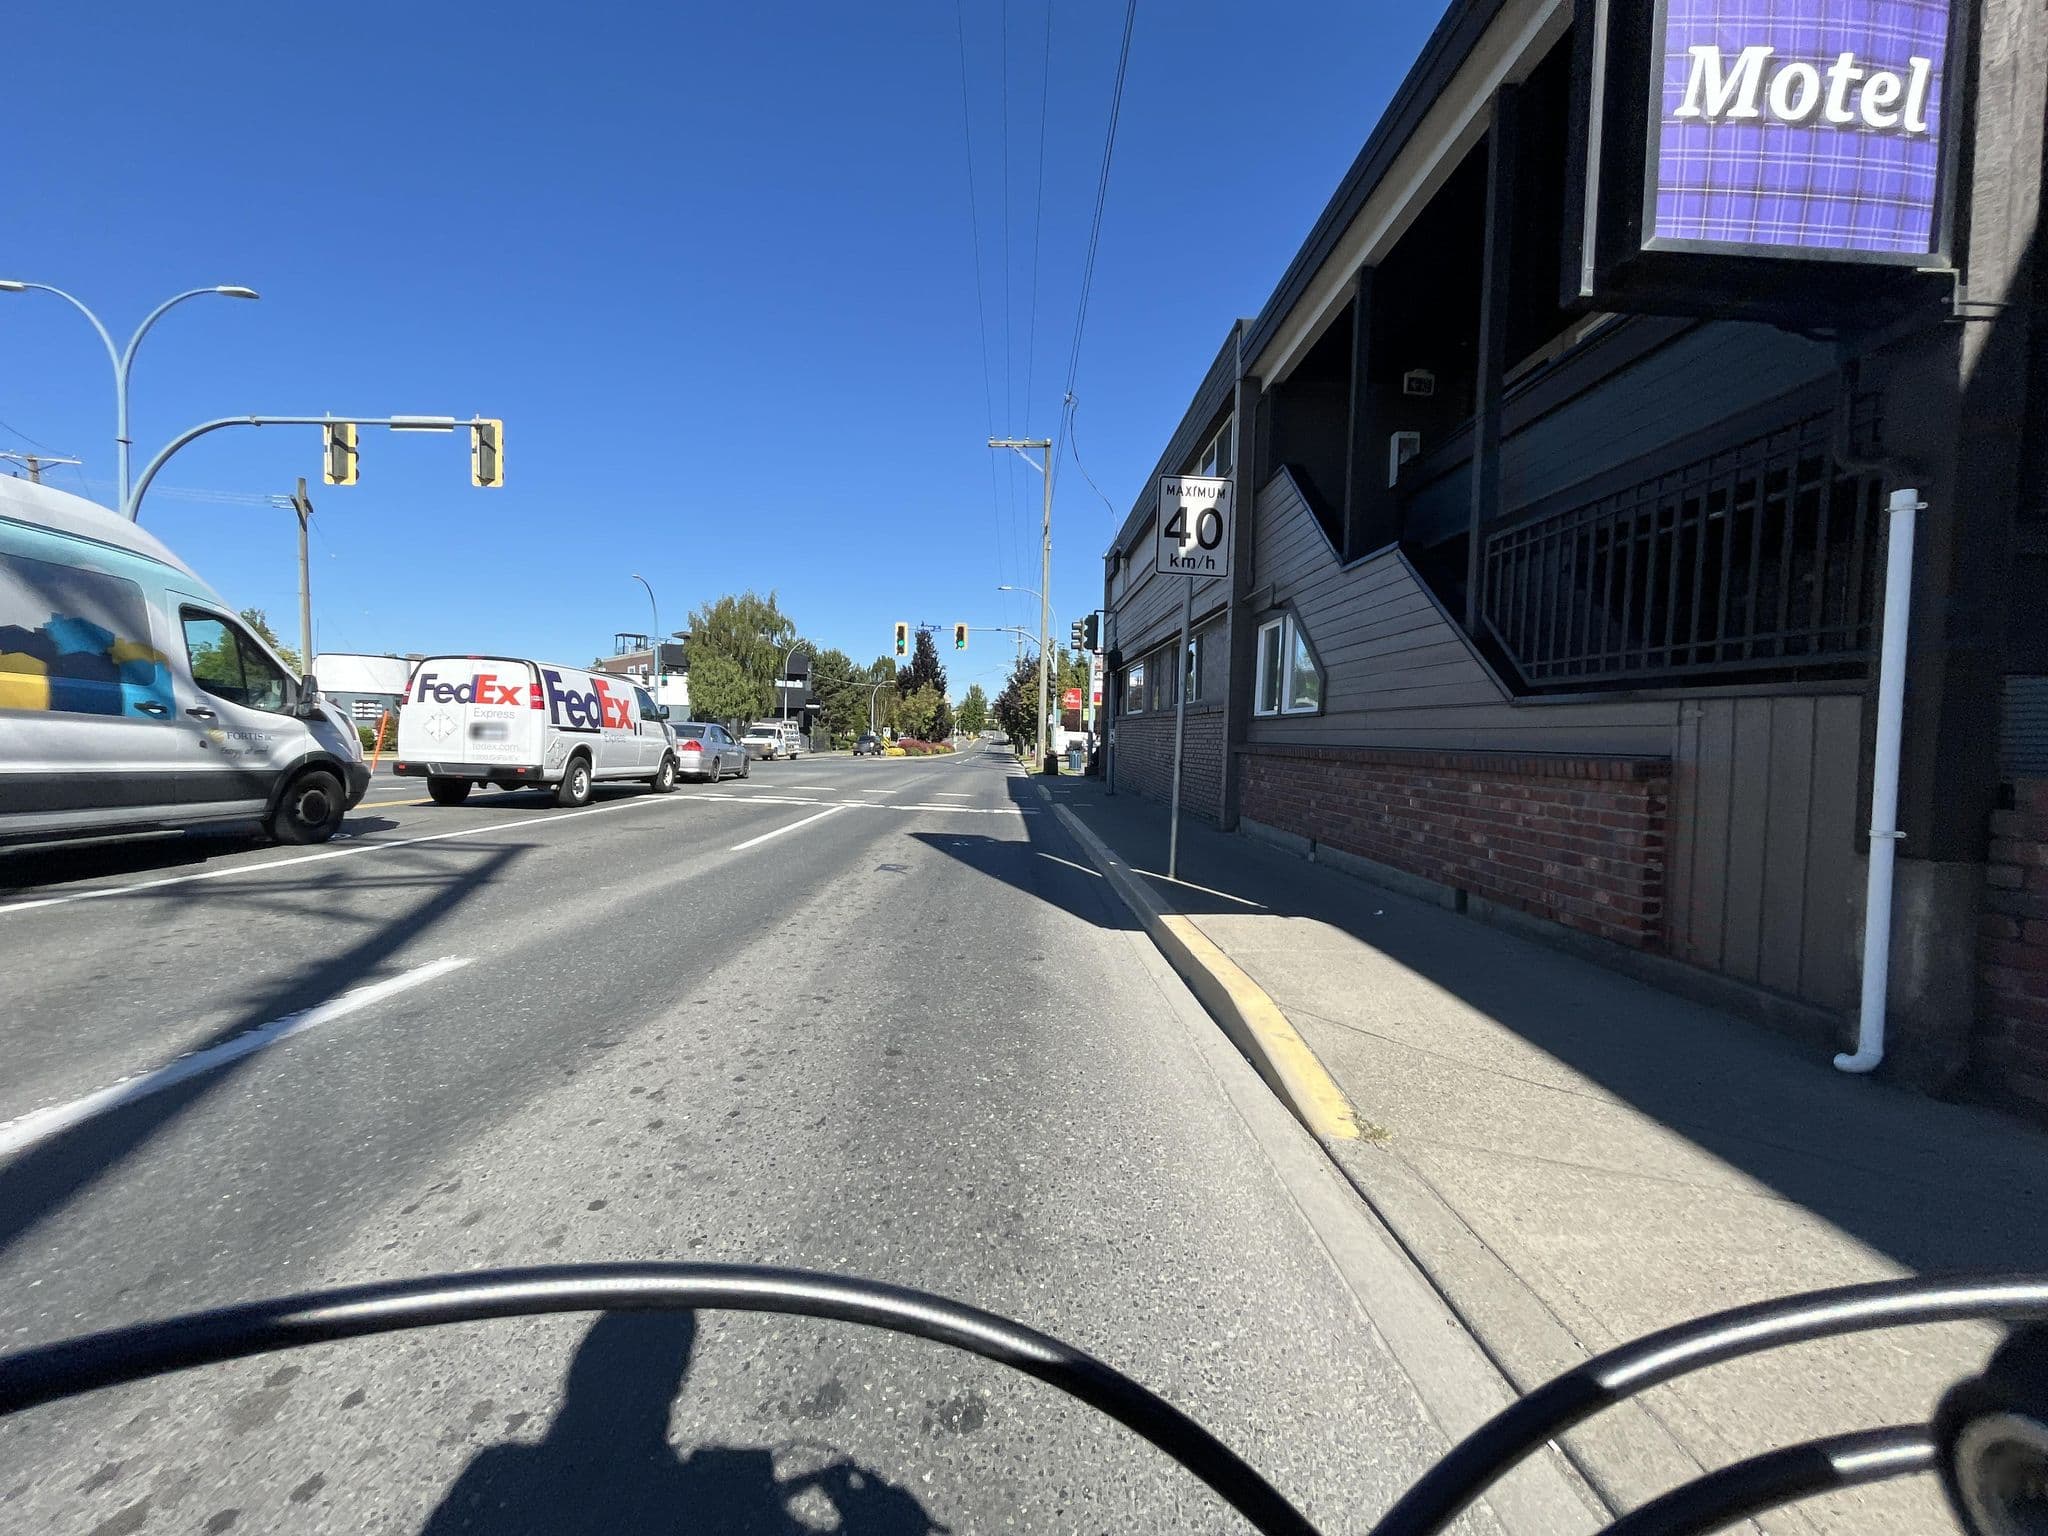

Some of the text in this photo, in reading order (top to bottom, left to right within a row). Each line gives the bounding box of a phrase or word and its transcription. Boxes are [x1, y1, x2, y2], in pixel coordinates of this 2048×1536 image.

[1673, 45, 1931, 133] Motel
[1166, 484, 1226, 499] MAXIMUM
[1164, 506, 1223, 550] 40
[1169, 553, 1216, 570] km/h
[416, 673, 523, 706] FedEx
[541, 668, 634, 729] FedEx
[473, 707, 516, 719] Express
